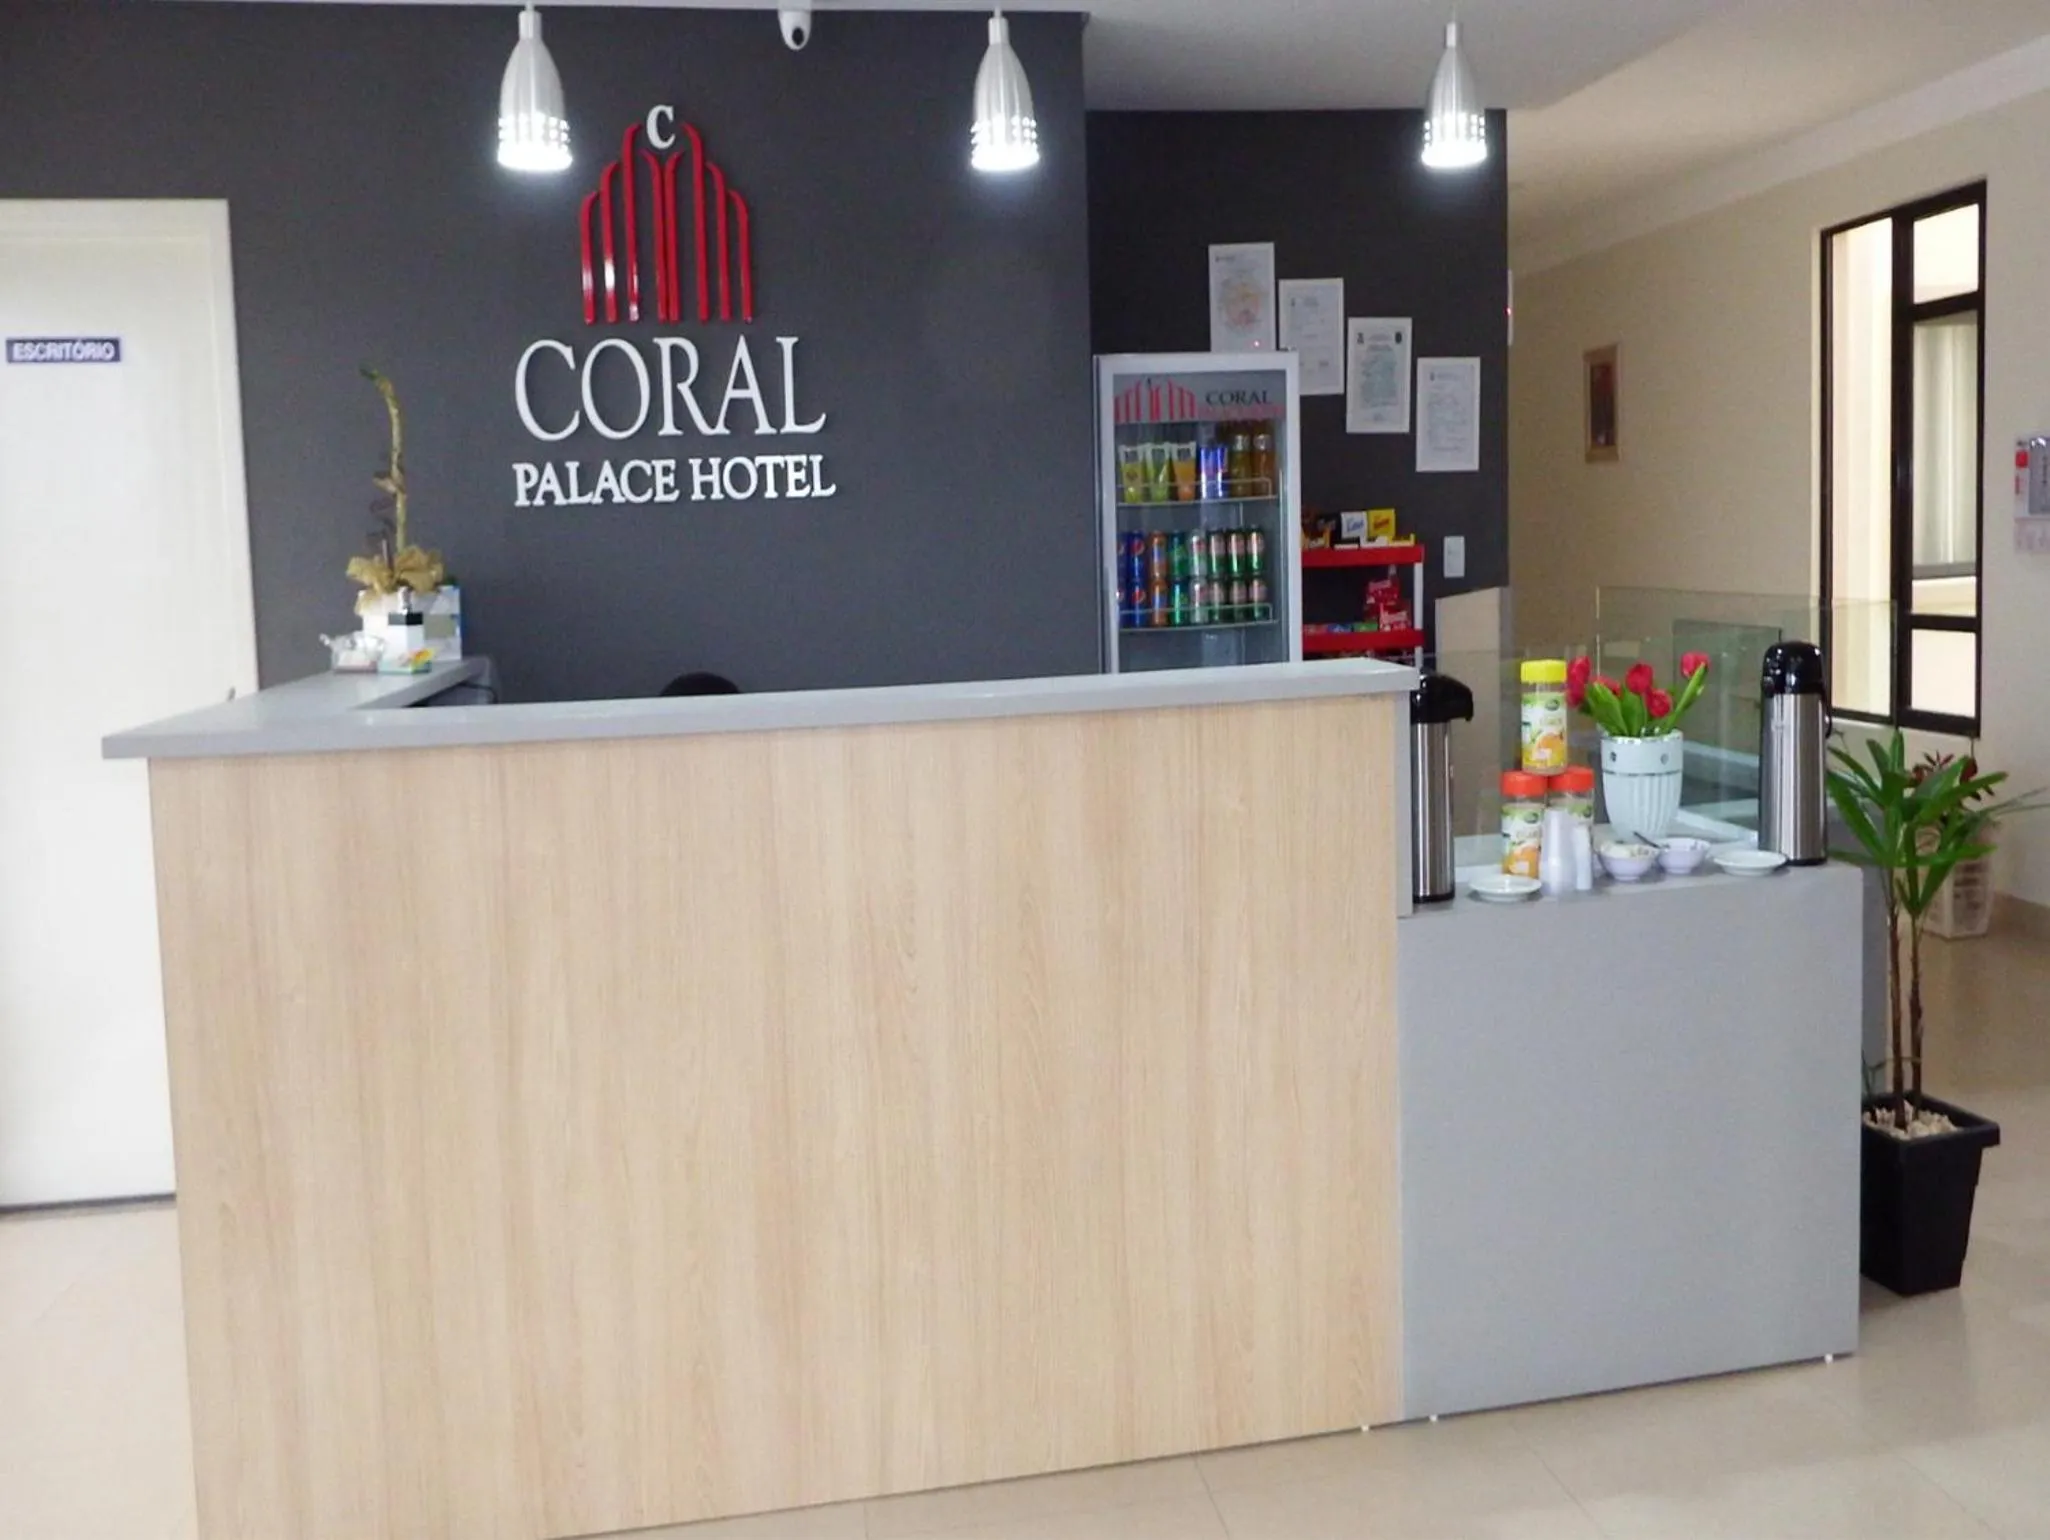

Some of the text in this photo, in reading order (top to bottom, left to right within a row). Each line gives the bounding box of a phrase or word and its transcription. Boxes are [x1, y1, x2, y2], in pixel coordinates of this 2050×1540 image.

[646, 104, 676, 149] C
[515, 334, 827, 441] CORAL
[512, 455, 837, 507] PALACE HOTEL
